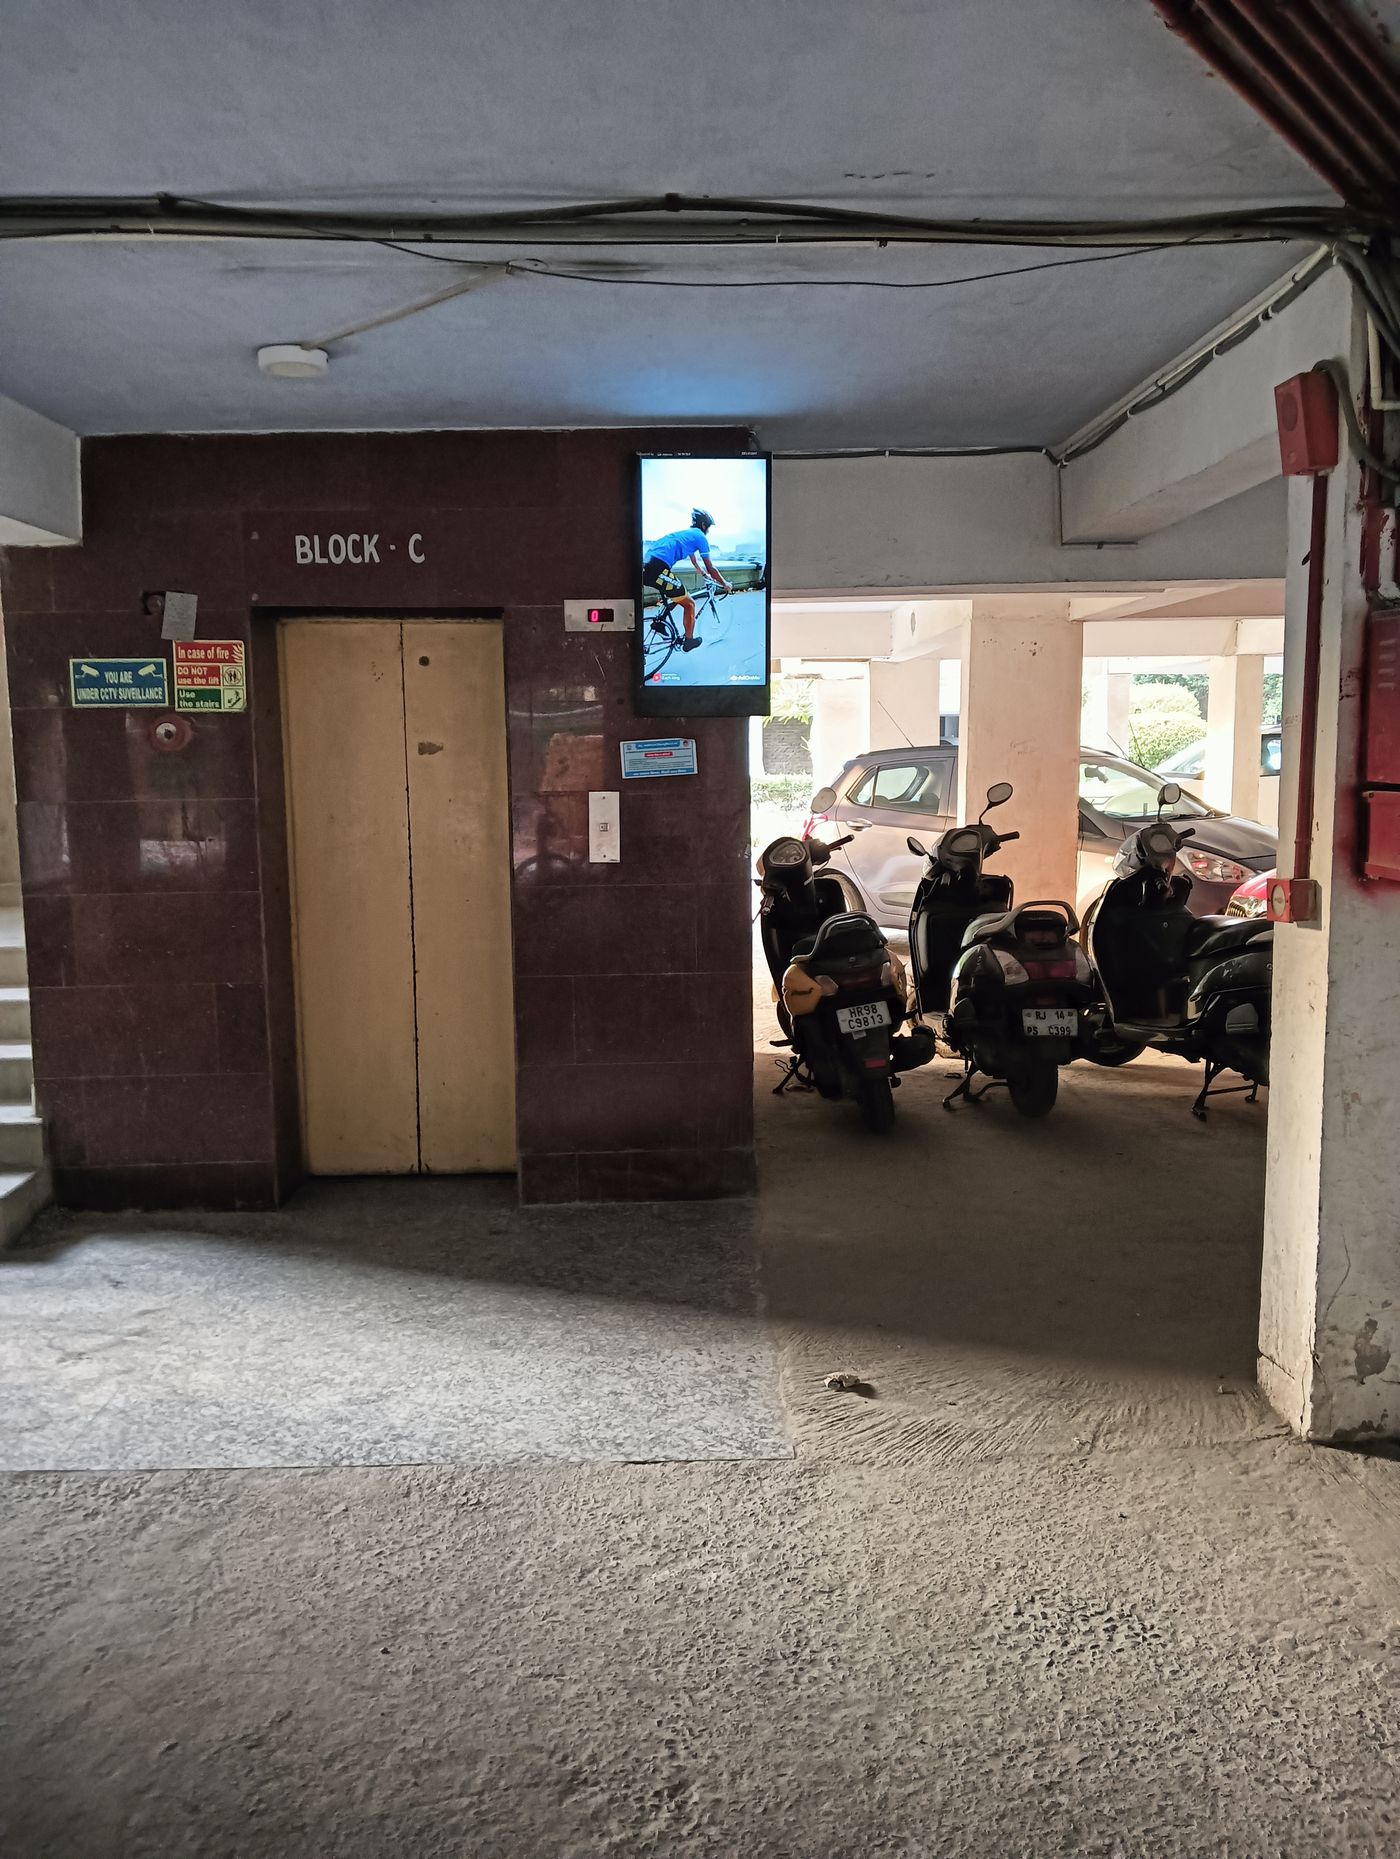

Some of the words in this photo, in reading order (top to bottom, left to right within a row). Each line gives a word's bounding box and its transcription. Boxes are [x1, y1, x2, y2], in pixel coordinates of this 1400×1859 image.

[295, 533, 381, 564] BLOCK
[408, 533, 426, 564] C
[591, 610, 599, 622] 0
[178, 646, 186, 659] In
[187, 648, 206, 660] case
[207, 647, 215, 660] of
[216, 646, 230, 660] fire
[104, 671, 119, 684] YOU
[119, 671, 133, 684] ARE
[177, 667, 189, 675] DO
[191, 667, 208, 676] NOT
[194, 677, 207, 685] the
[208, 676, 220, 686] lift
[76, 687, 100, 701] UNDER
[100, 687, 118, 701] CCTV
[179, 690, 196, 699] Use
[179, 699, 193, 708] the
[195, 699, 220, 709] stairs
[848, 1004, 878, 1019] HR98
[1035, 1010, 1047, 1020] RJ
[1055, 1010, 1065, 1020] 14
[848, 1013, 884, 1030] C9813
